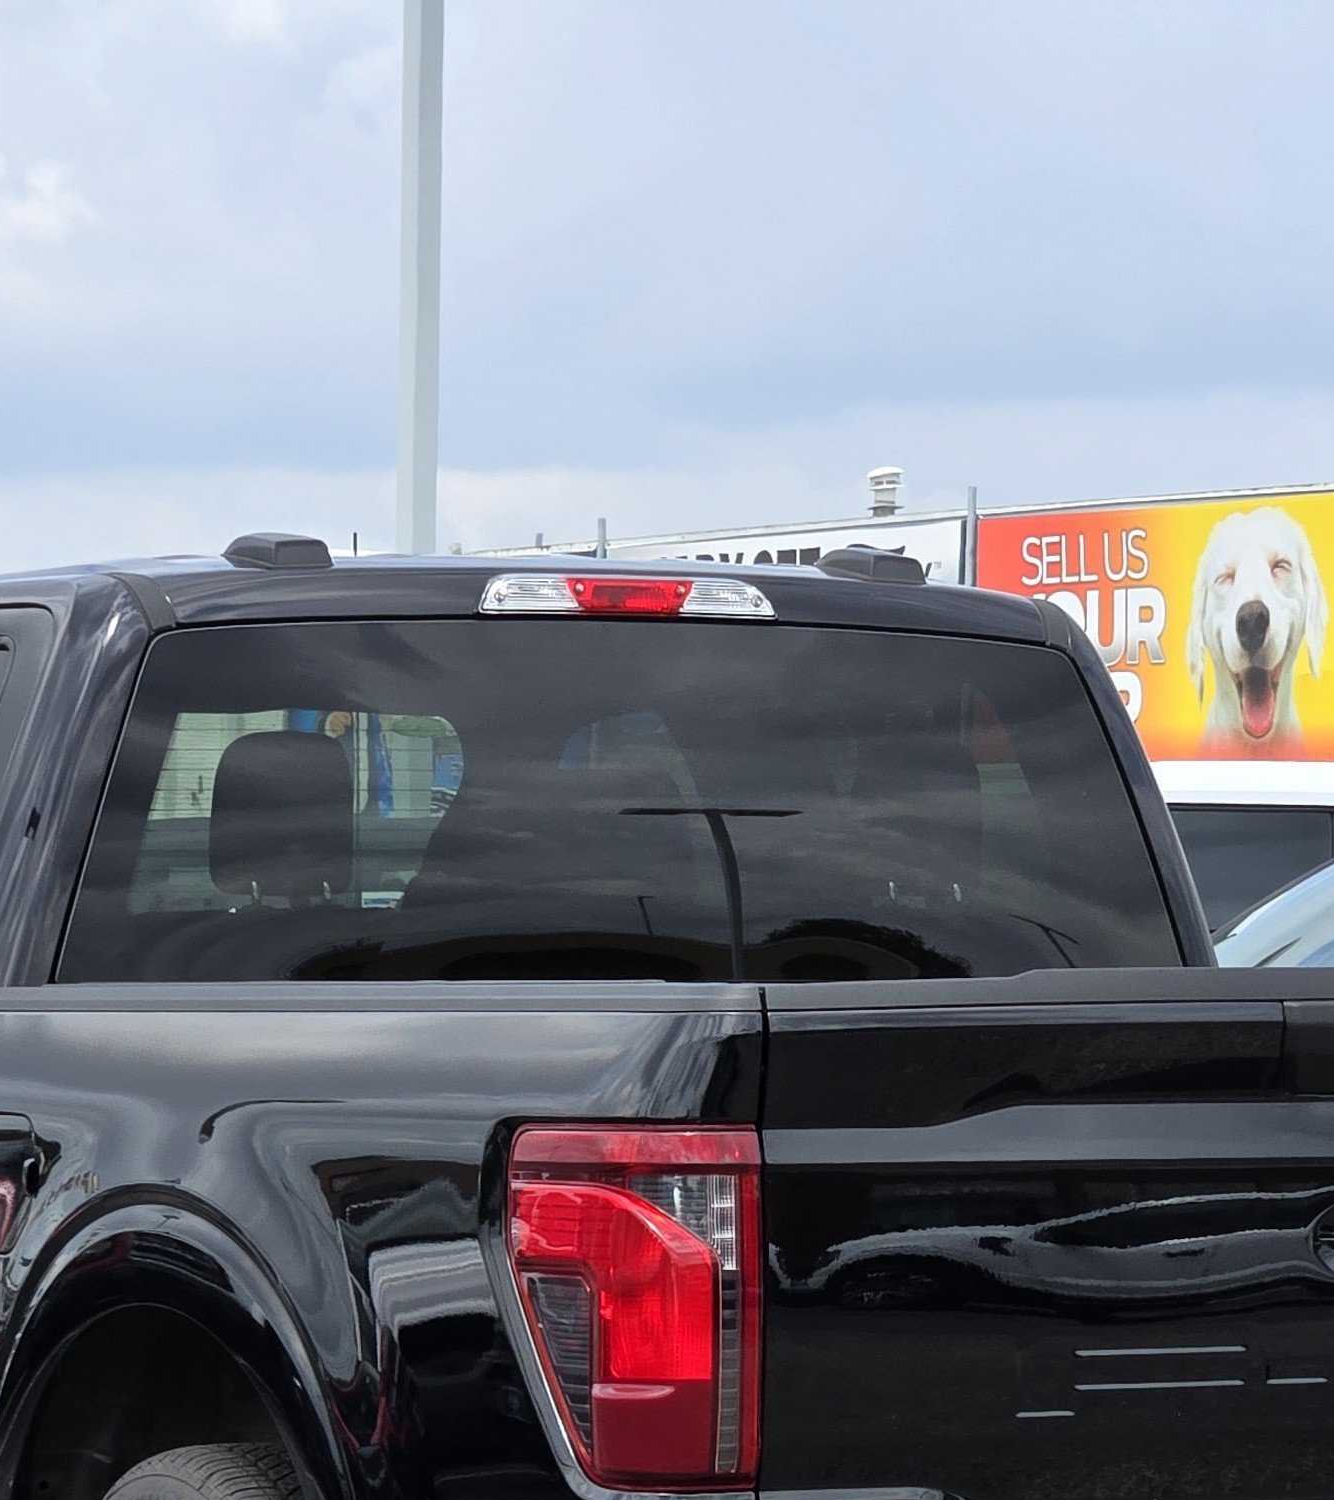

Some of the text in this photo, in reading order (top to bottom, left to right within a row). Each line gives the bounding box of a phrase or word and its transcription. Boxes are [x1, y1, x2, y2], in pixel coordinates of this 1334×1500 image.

[1022, 529, 1149, 585] SELL US
[1033, 587, 1166, 667] UR
